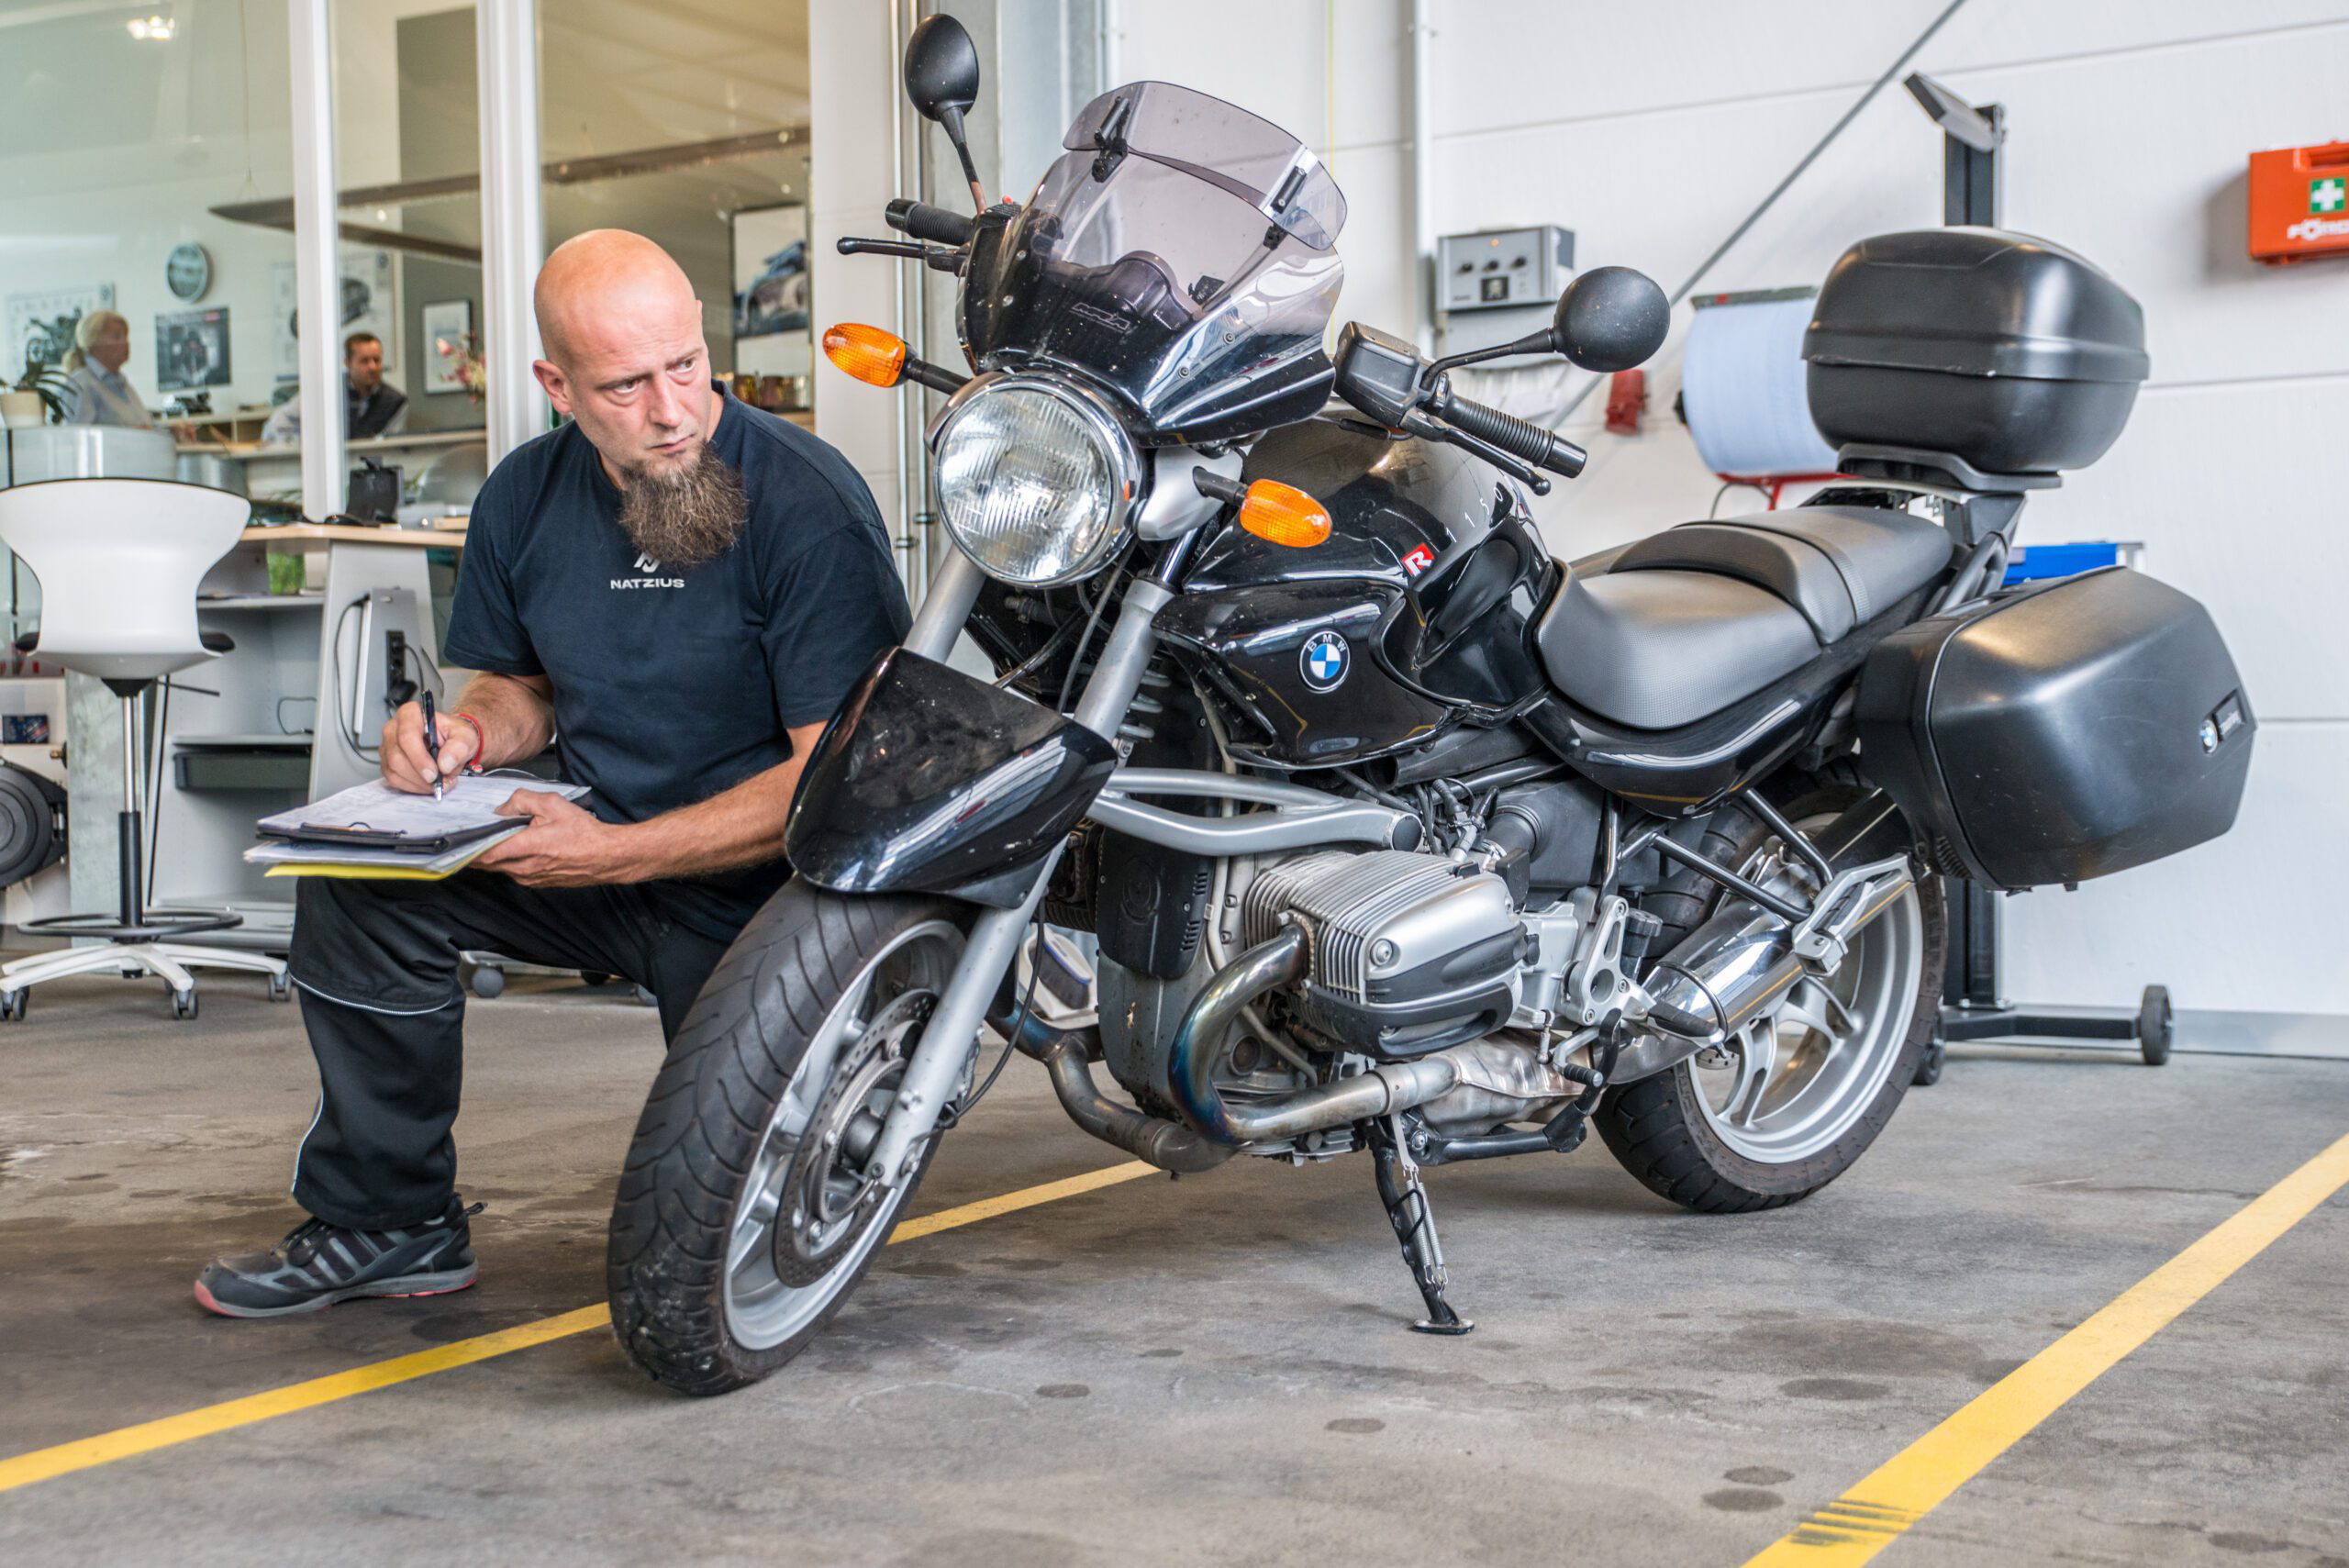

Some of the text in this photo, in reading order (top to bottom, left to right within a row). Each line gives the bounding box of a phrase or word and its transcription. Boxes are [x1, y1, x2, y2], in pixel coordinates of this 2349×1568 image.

[1405, 486, 1503, 576] R 1150
[610, 578, 685, 589] NATZIUS
[1307, 633, 1346, 652] BMW
